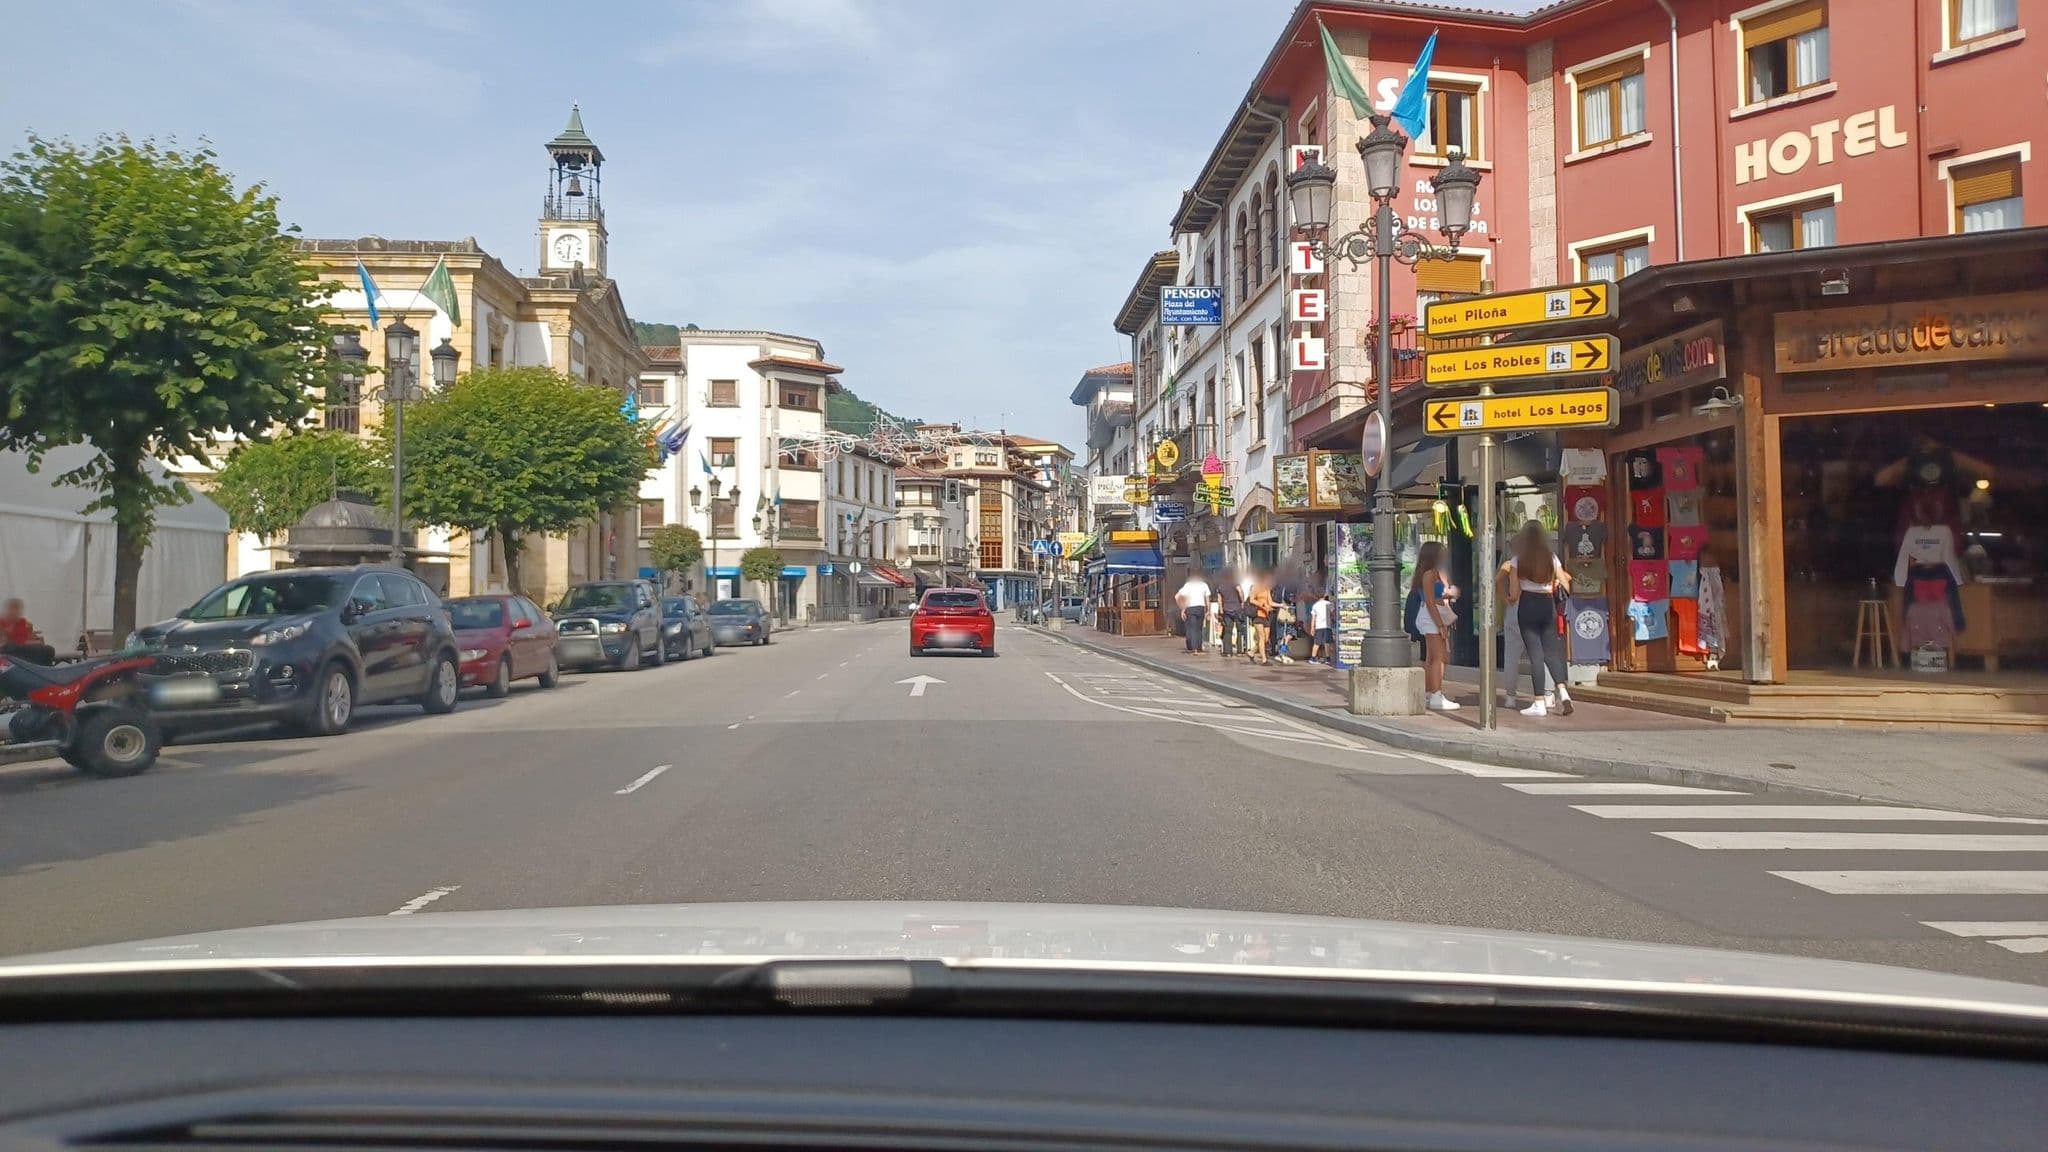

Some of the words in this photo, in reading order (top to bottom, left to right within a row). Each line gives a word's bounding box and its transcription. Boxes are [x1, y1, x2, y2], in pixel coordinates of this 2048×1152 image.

[1734, 104, 1908, 186] HOTEL
[1407, 215, 1427, 231] DE
[1164, 288, 1221, 299] PENSION
[1431, 314, 1457, 325] hotel
[1465, 307, 1507, 322] Piloña
[1430, 363, 1456, 374] hotel
[1464, 359, 1487, 371] Los
[1493, 355, 1540, 369] Robles
[1494, 408, 1521, 419] hotel
[1530, 405, 1554, 417] Los
[1560, 403, 1603, 416] Lagos
